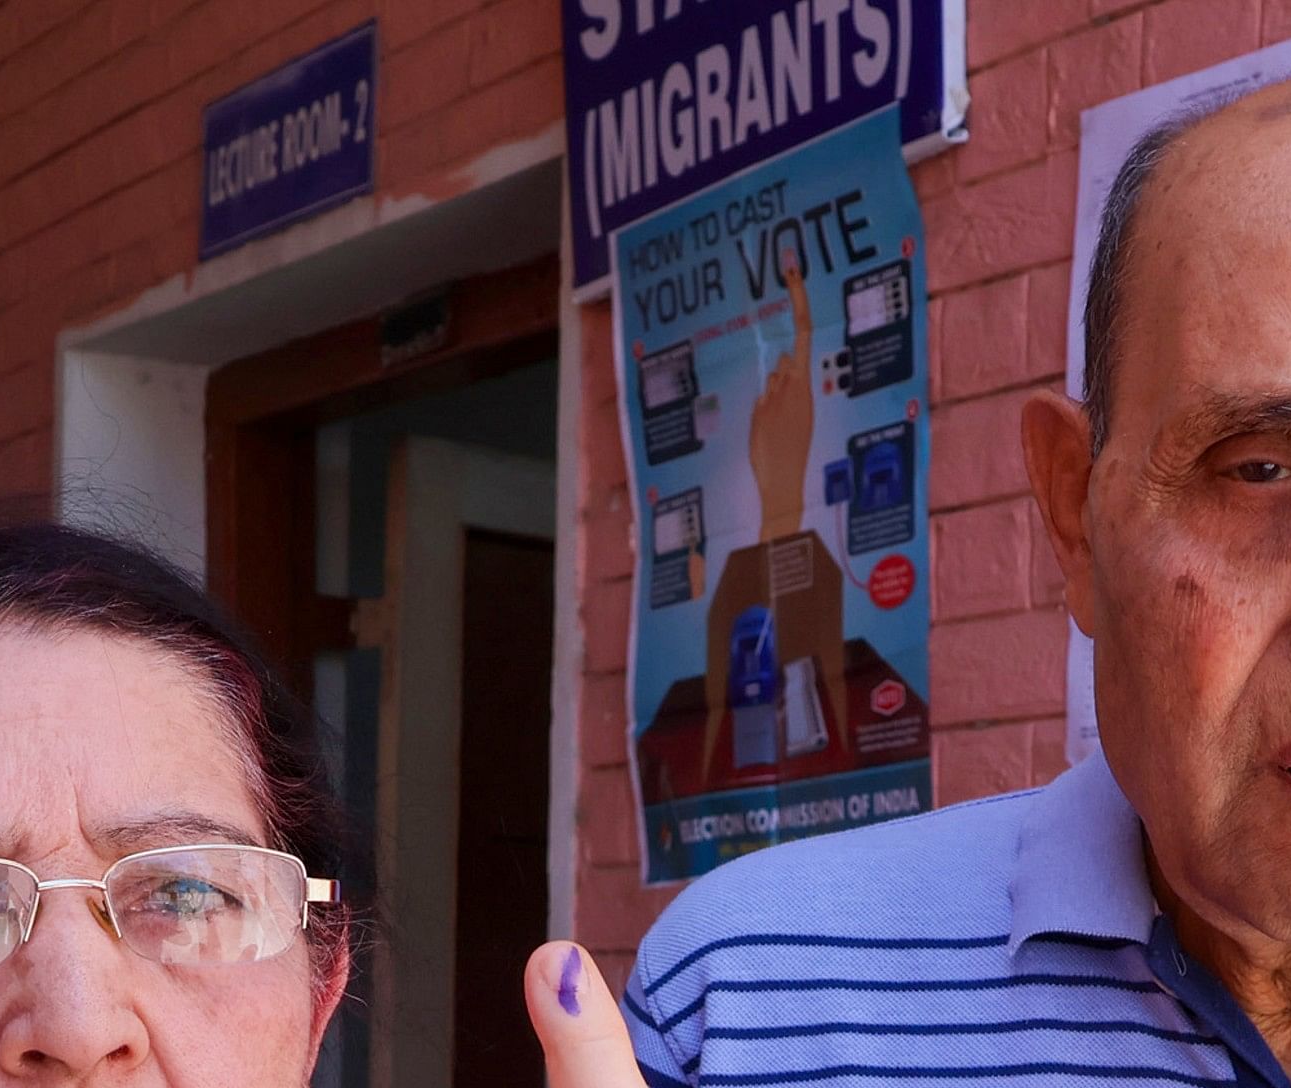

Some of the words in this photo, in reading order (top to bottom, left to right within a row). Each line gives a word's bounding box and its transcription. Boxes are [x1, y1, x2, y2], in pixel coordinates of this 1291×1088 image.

[584, 0, 913, 239] (MIGRANTS)
[629, 230, 685, 279] HOW
[689, 211, 722, 248] TO
[725, 180, 789, 235] CAST
[633, 258, 725, 332] YOUR
[736, 190, 878, 300] VOTE
[678, 813, 745, 844] ELECTION
[745, 799, 845, 834] COMMISSION
[847, 794, 871, 819] OF
[872, 787, 920, 816] INDIA
